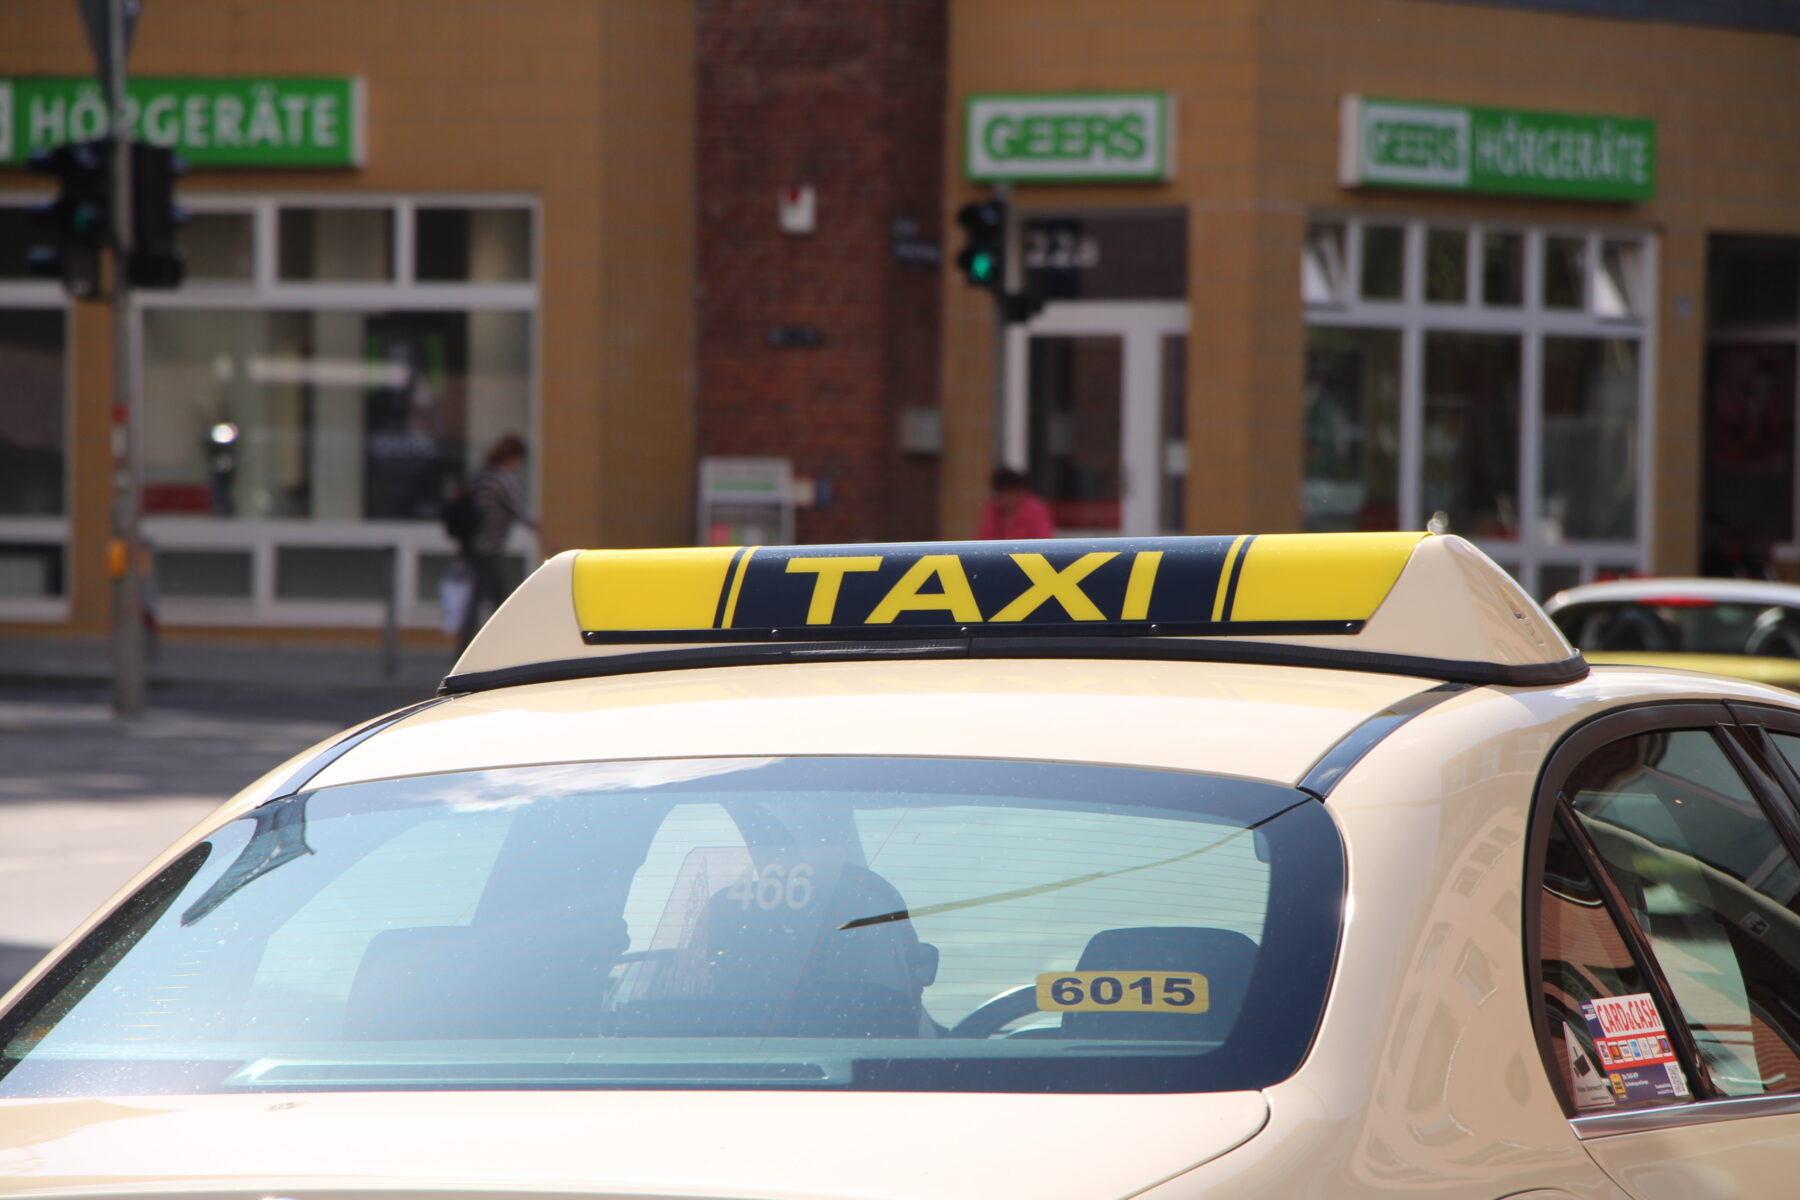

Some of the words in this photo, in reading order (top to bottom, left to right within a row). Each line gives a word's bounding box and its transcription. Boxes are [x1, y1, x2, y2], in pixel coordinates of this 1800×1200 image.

[982, 112, 1146, 160] GEERS
[784, 550, 1164, 625] TAXI
[727, 863, 816, 911] 466
[1051, 976, 1196, 1007] 6015
